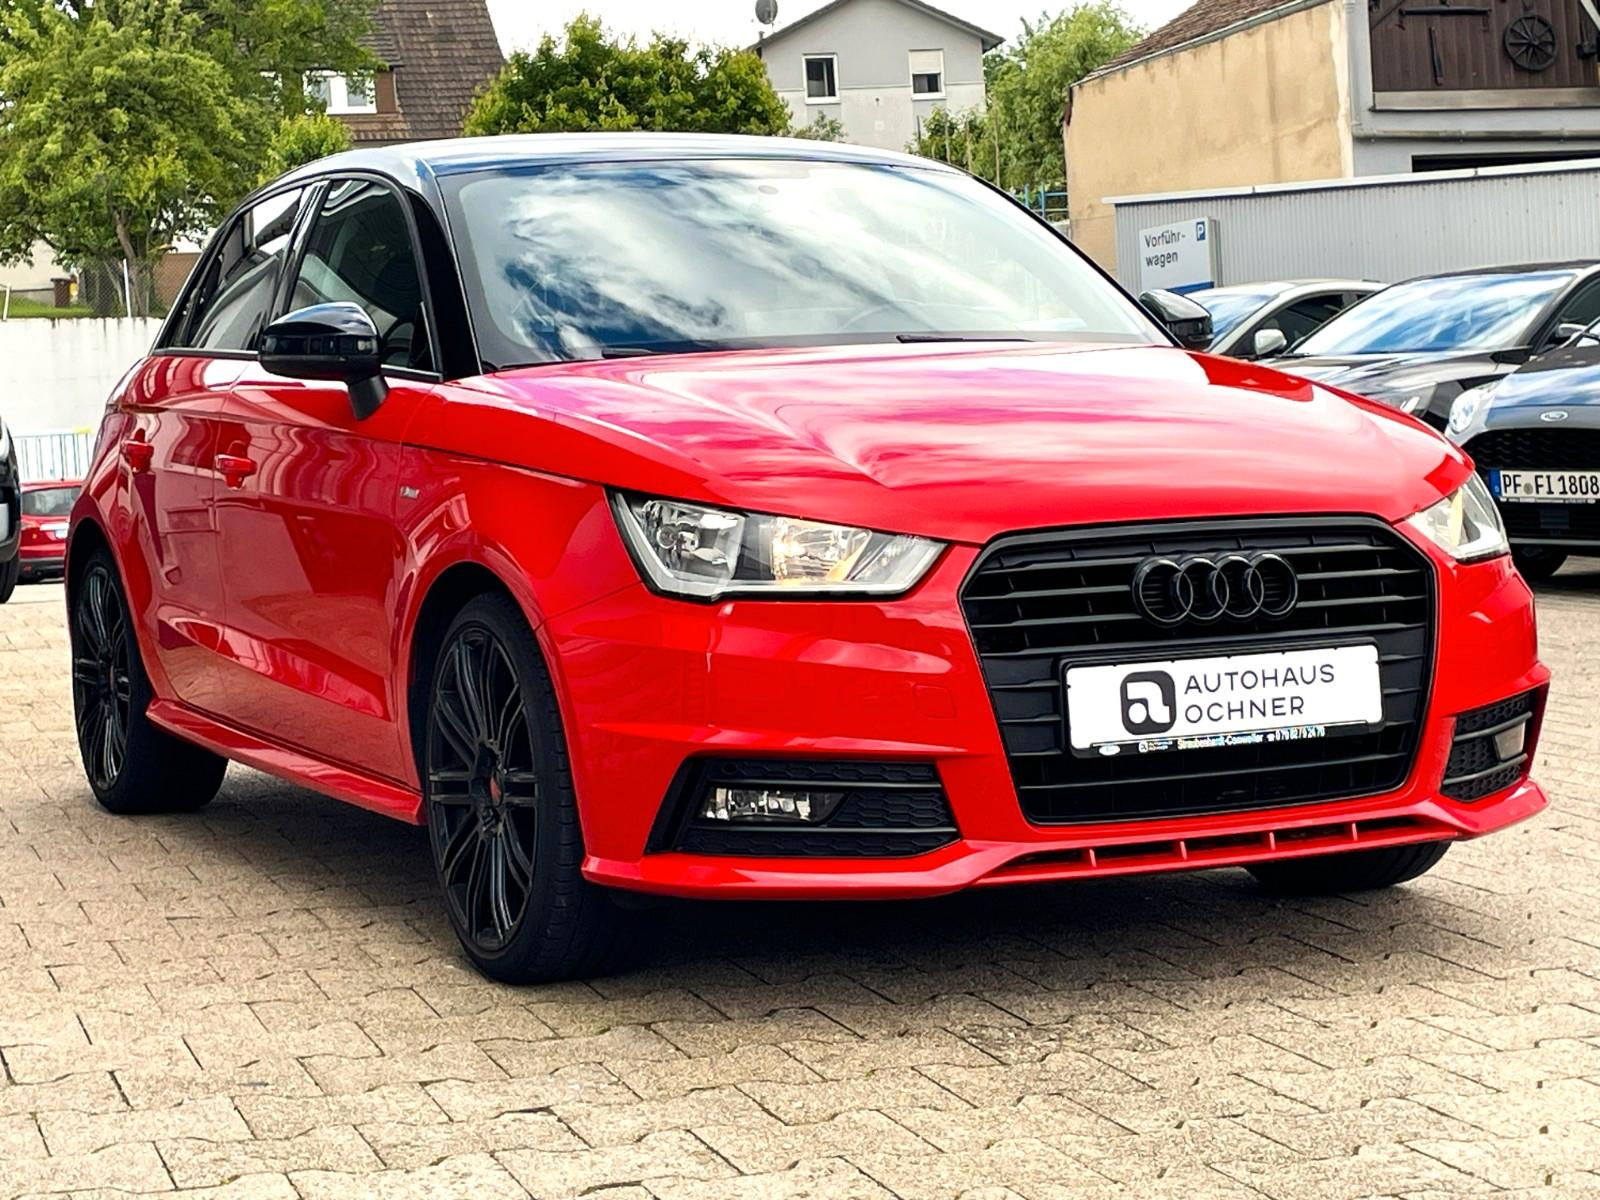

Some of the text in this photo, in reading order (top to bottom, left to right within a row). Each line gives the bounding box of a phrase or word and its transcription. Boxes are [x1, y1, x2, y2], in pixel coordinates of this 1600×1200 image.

[1144, 230, 1186, 248] Vorführ-
[1145, 251, 1178, 268] wagen
[1502, 474, 1600, 495] PF FI 1808
[1184, 663, 1336, 695] AUTOHAUS
[1184, 695, 1305, 724] OCHNER
